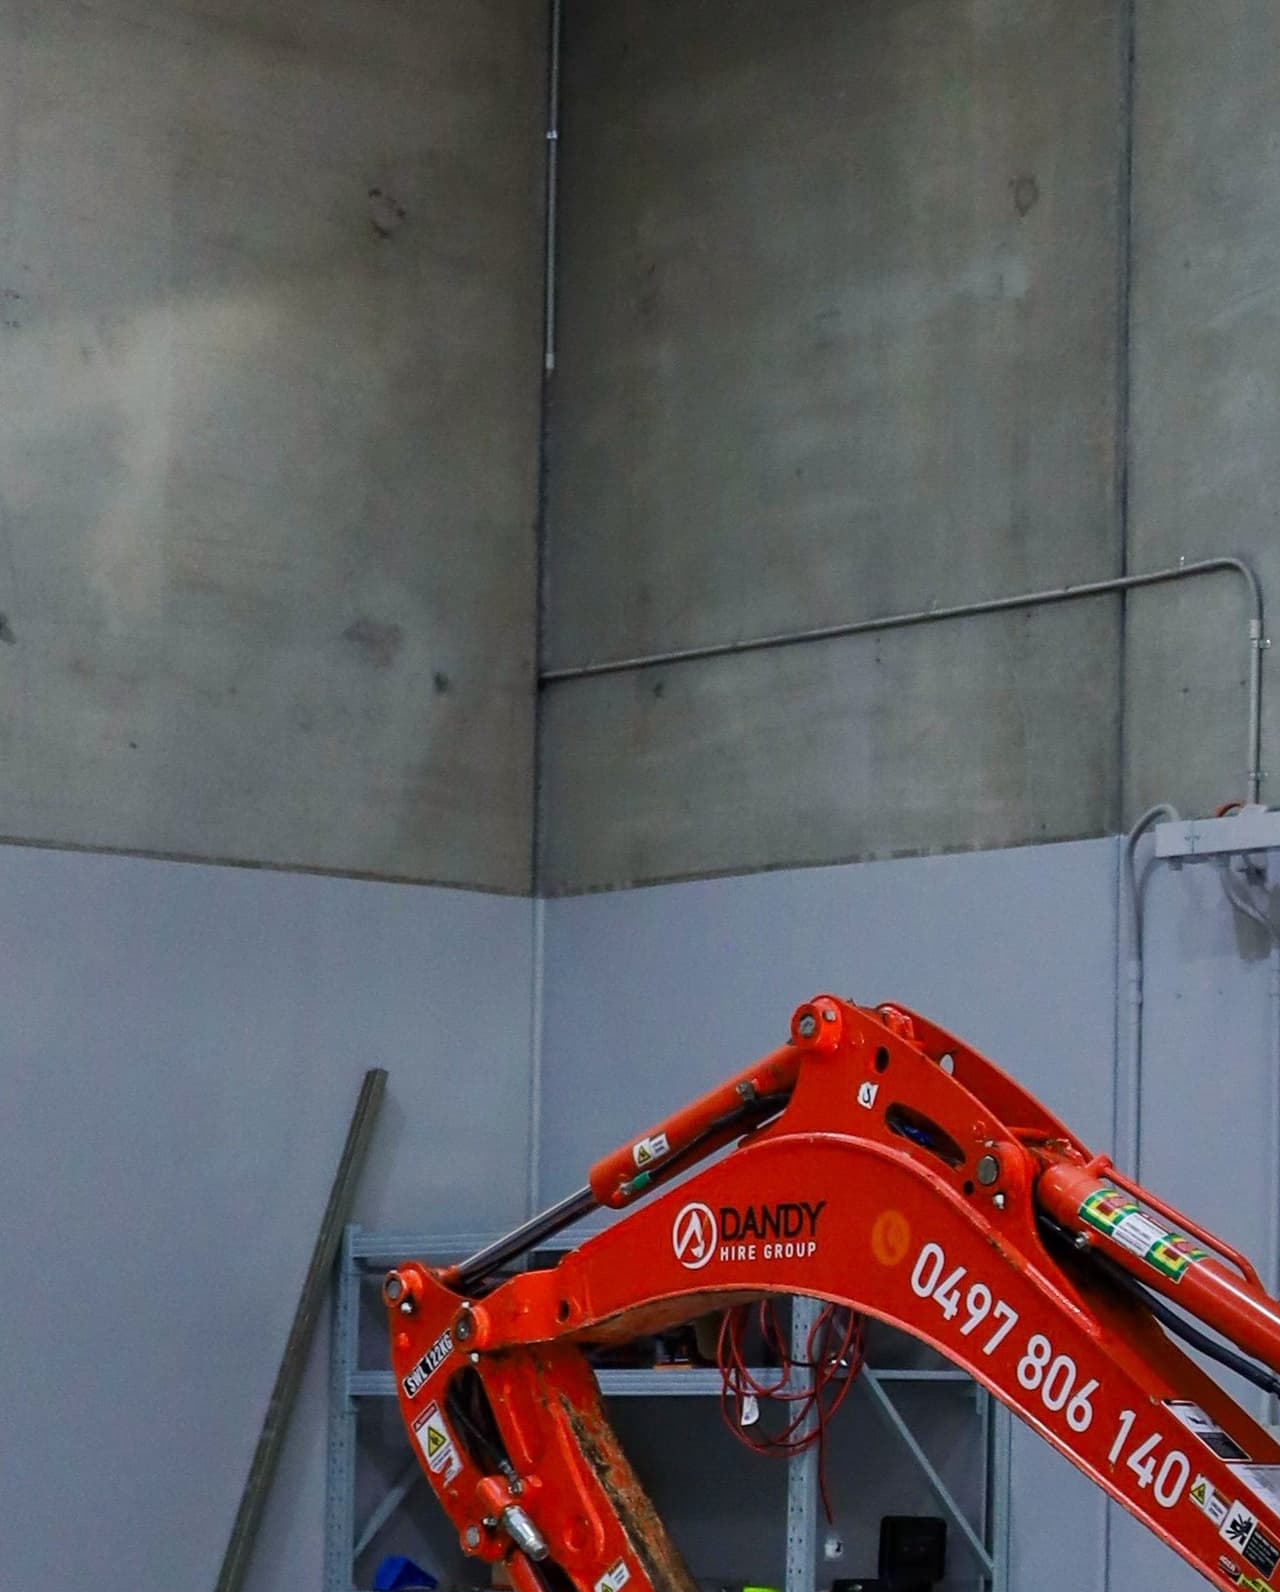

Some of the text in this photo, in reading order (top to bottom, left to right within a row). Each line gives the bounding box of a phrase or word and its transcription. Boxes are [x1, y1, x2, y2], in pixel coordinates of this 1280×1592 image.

[720, 1201, 825, 1240] DANDY
[720, 1242, 816, 1261] HIRE GROUP
[407, 1365, 427, 1392] SWL
[911, 1243, 1019, 1355] 0497
[1017, 1334, 1099, 1432] 806
[1107, 1409, 1190, 1508] 140
